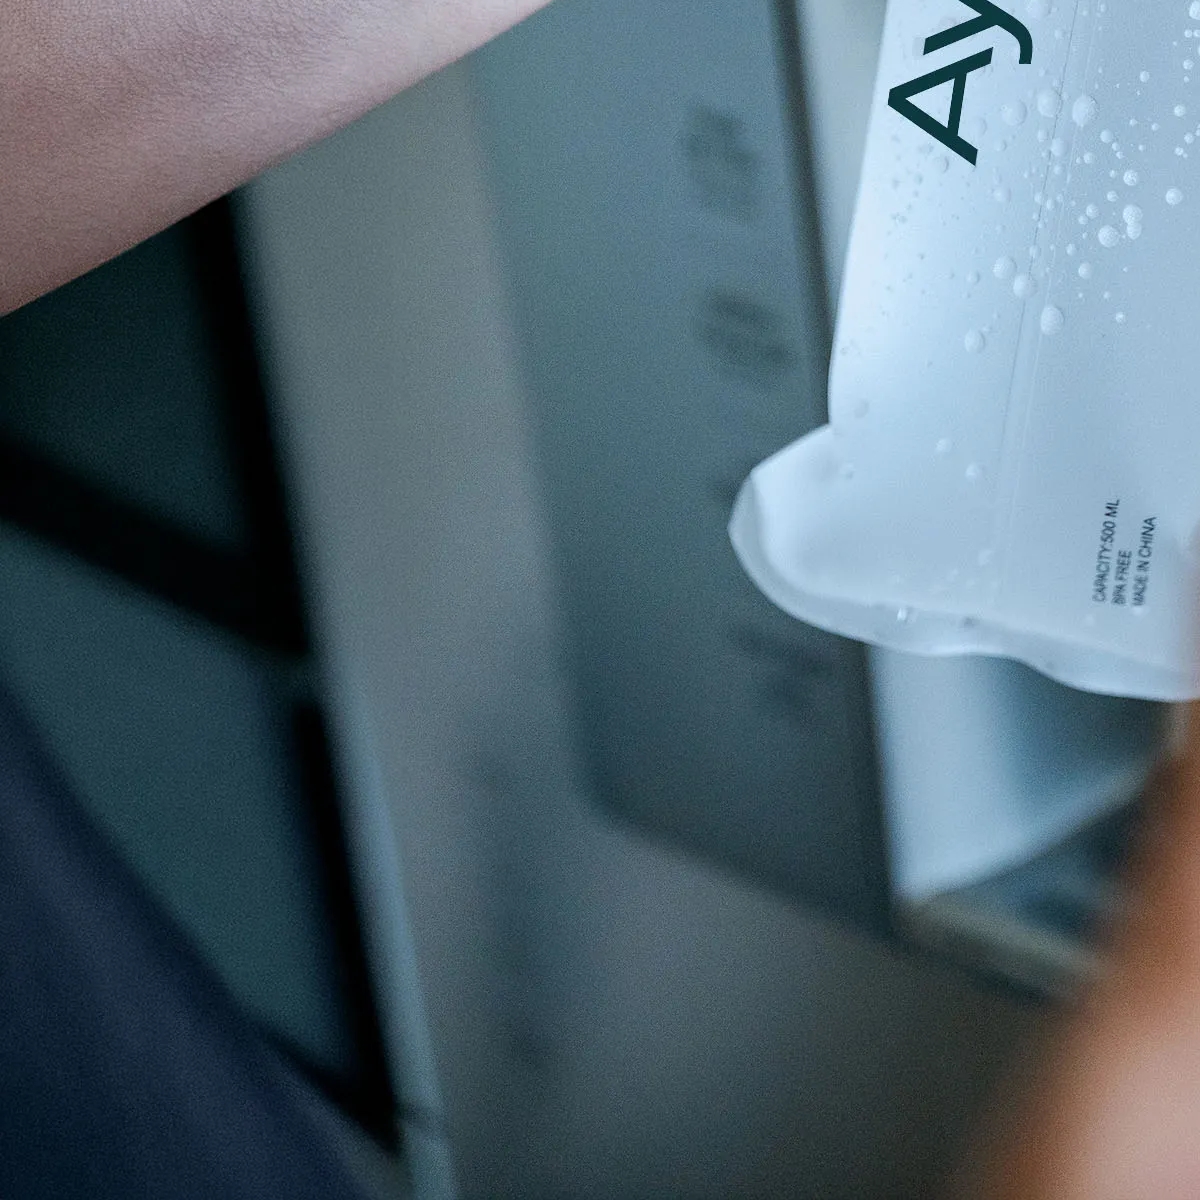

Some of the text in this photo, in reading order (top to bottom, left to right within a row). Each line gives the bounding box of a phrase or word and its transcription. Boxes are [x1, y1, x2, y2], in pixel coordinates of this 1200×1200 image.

[1104, 499, 1120, 518] ML
[1114, 550, 1132, 581] FREE
[1132, 517, 1157, 606] MADE IN CHINA
